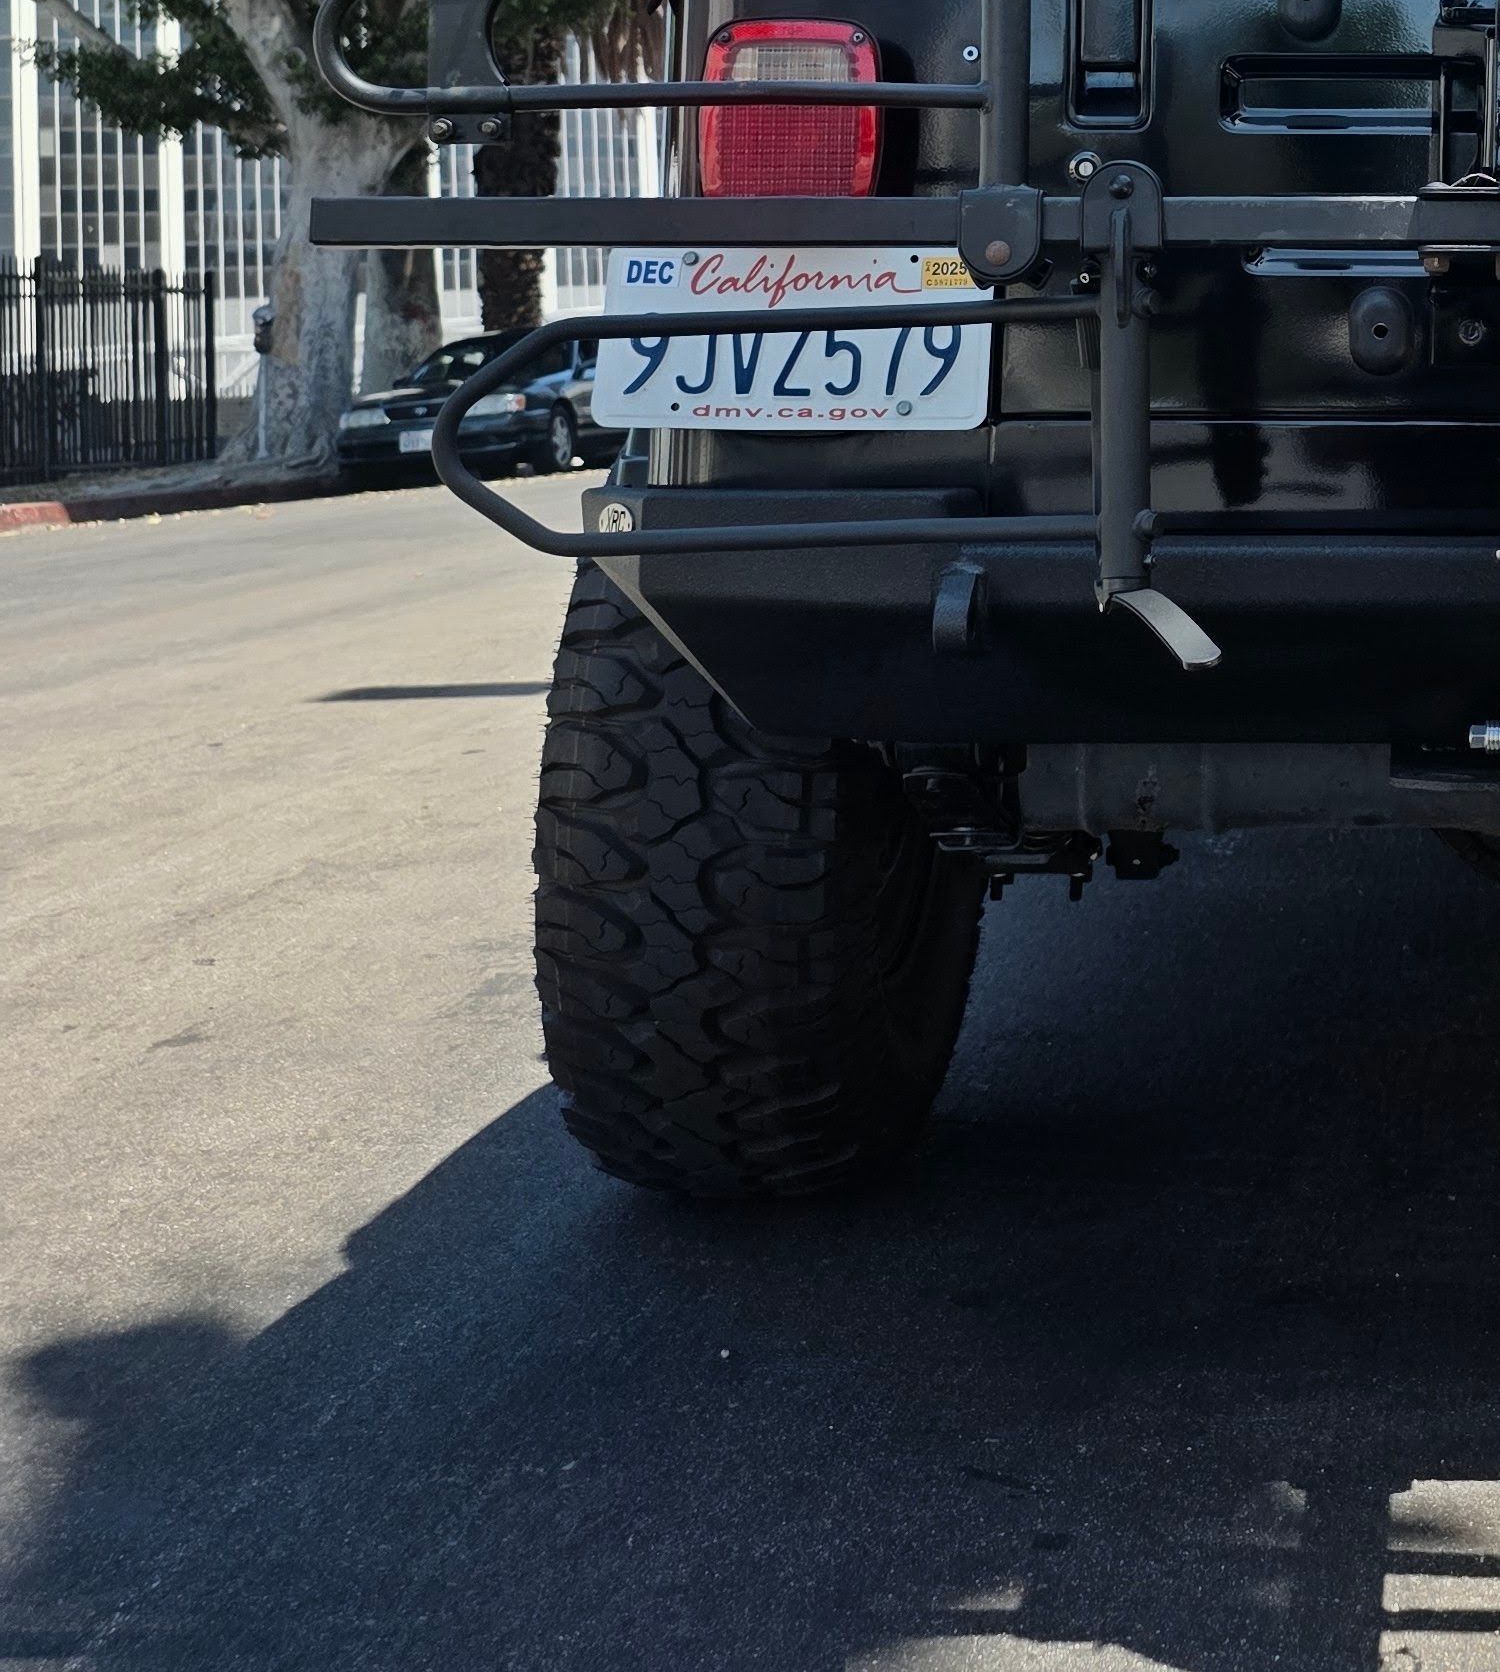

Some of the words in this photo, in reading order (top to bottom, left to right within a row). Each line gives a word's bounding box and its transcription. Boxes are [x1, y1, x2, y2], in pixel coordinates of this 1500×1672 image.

[626, 259, 675, 285] DEC
[932, 261, 968, 276] 2025
[690, 253, 922, 308] California
[692, 403, 889, 421] dmv.ca.gov
